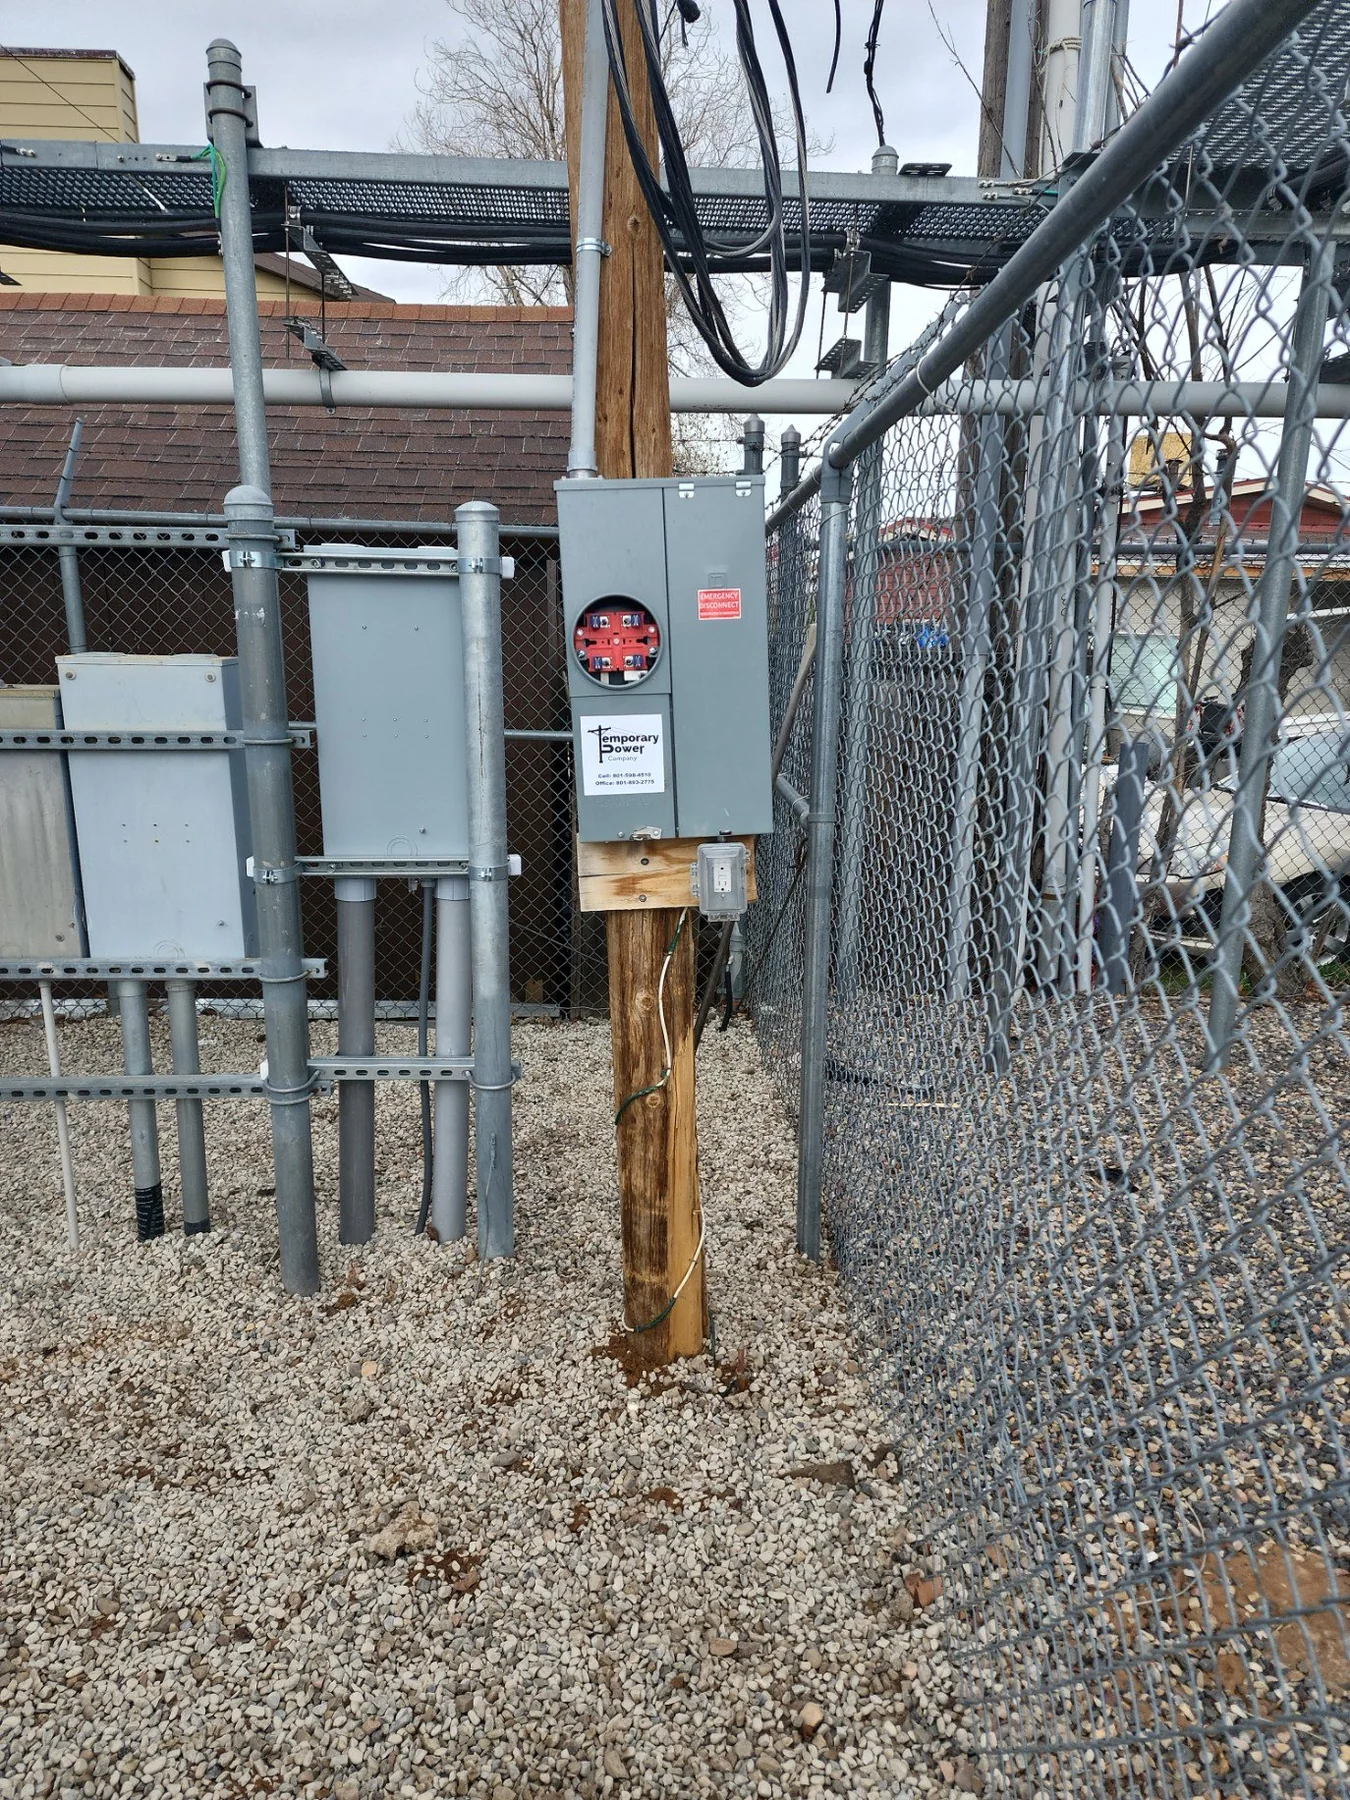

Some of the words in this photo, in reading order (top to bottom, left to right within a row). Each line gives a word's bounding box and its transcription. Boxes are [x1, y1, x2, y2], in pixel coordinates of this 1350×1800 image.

[700, 592, 738, 600] EMERGENCY
[700, 601, 738, 609] DISCONNECT
[588, 724, 659, 744] Temporary
[599, 744, 645, 762] Power
